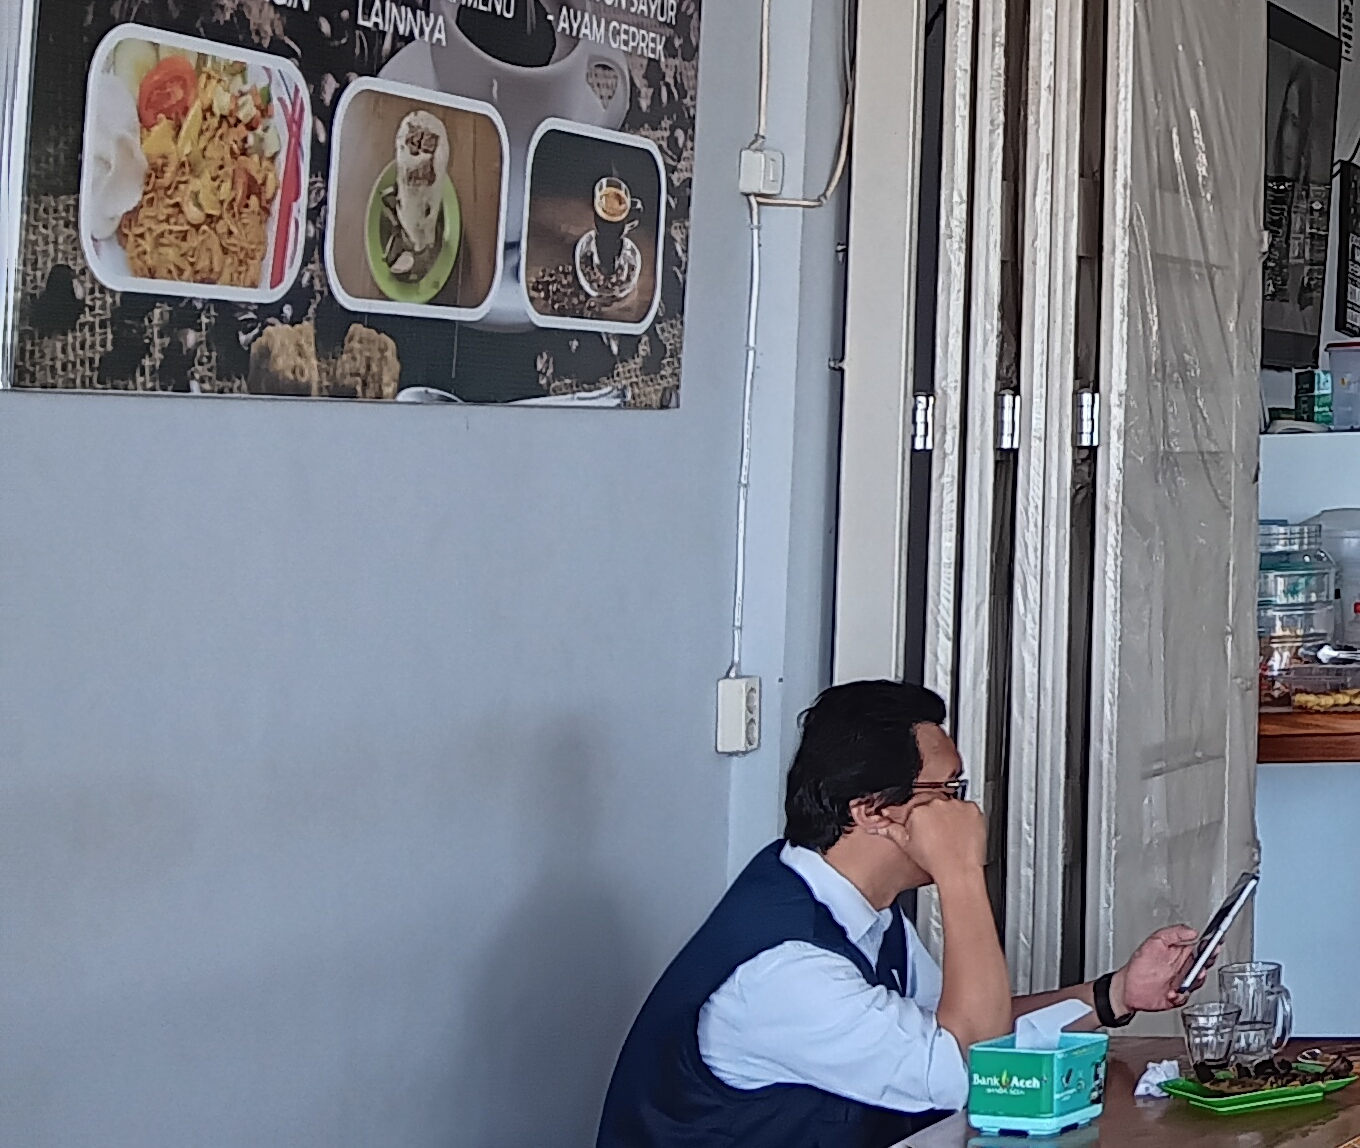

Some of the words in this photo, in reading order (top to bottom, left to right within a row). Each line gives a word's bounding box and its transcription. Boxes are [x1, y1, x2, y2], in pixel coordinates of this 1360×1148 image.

[556, 5, 606, 45] AYAM
[608, 20, 666, 63] GEPREK
[972, 1073, 1001, 1088] Bank
[1009, 1075, 1041, 1090] Aceh
